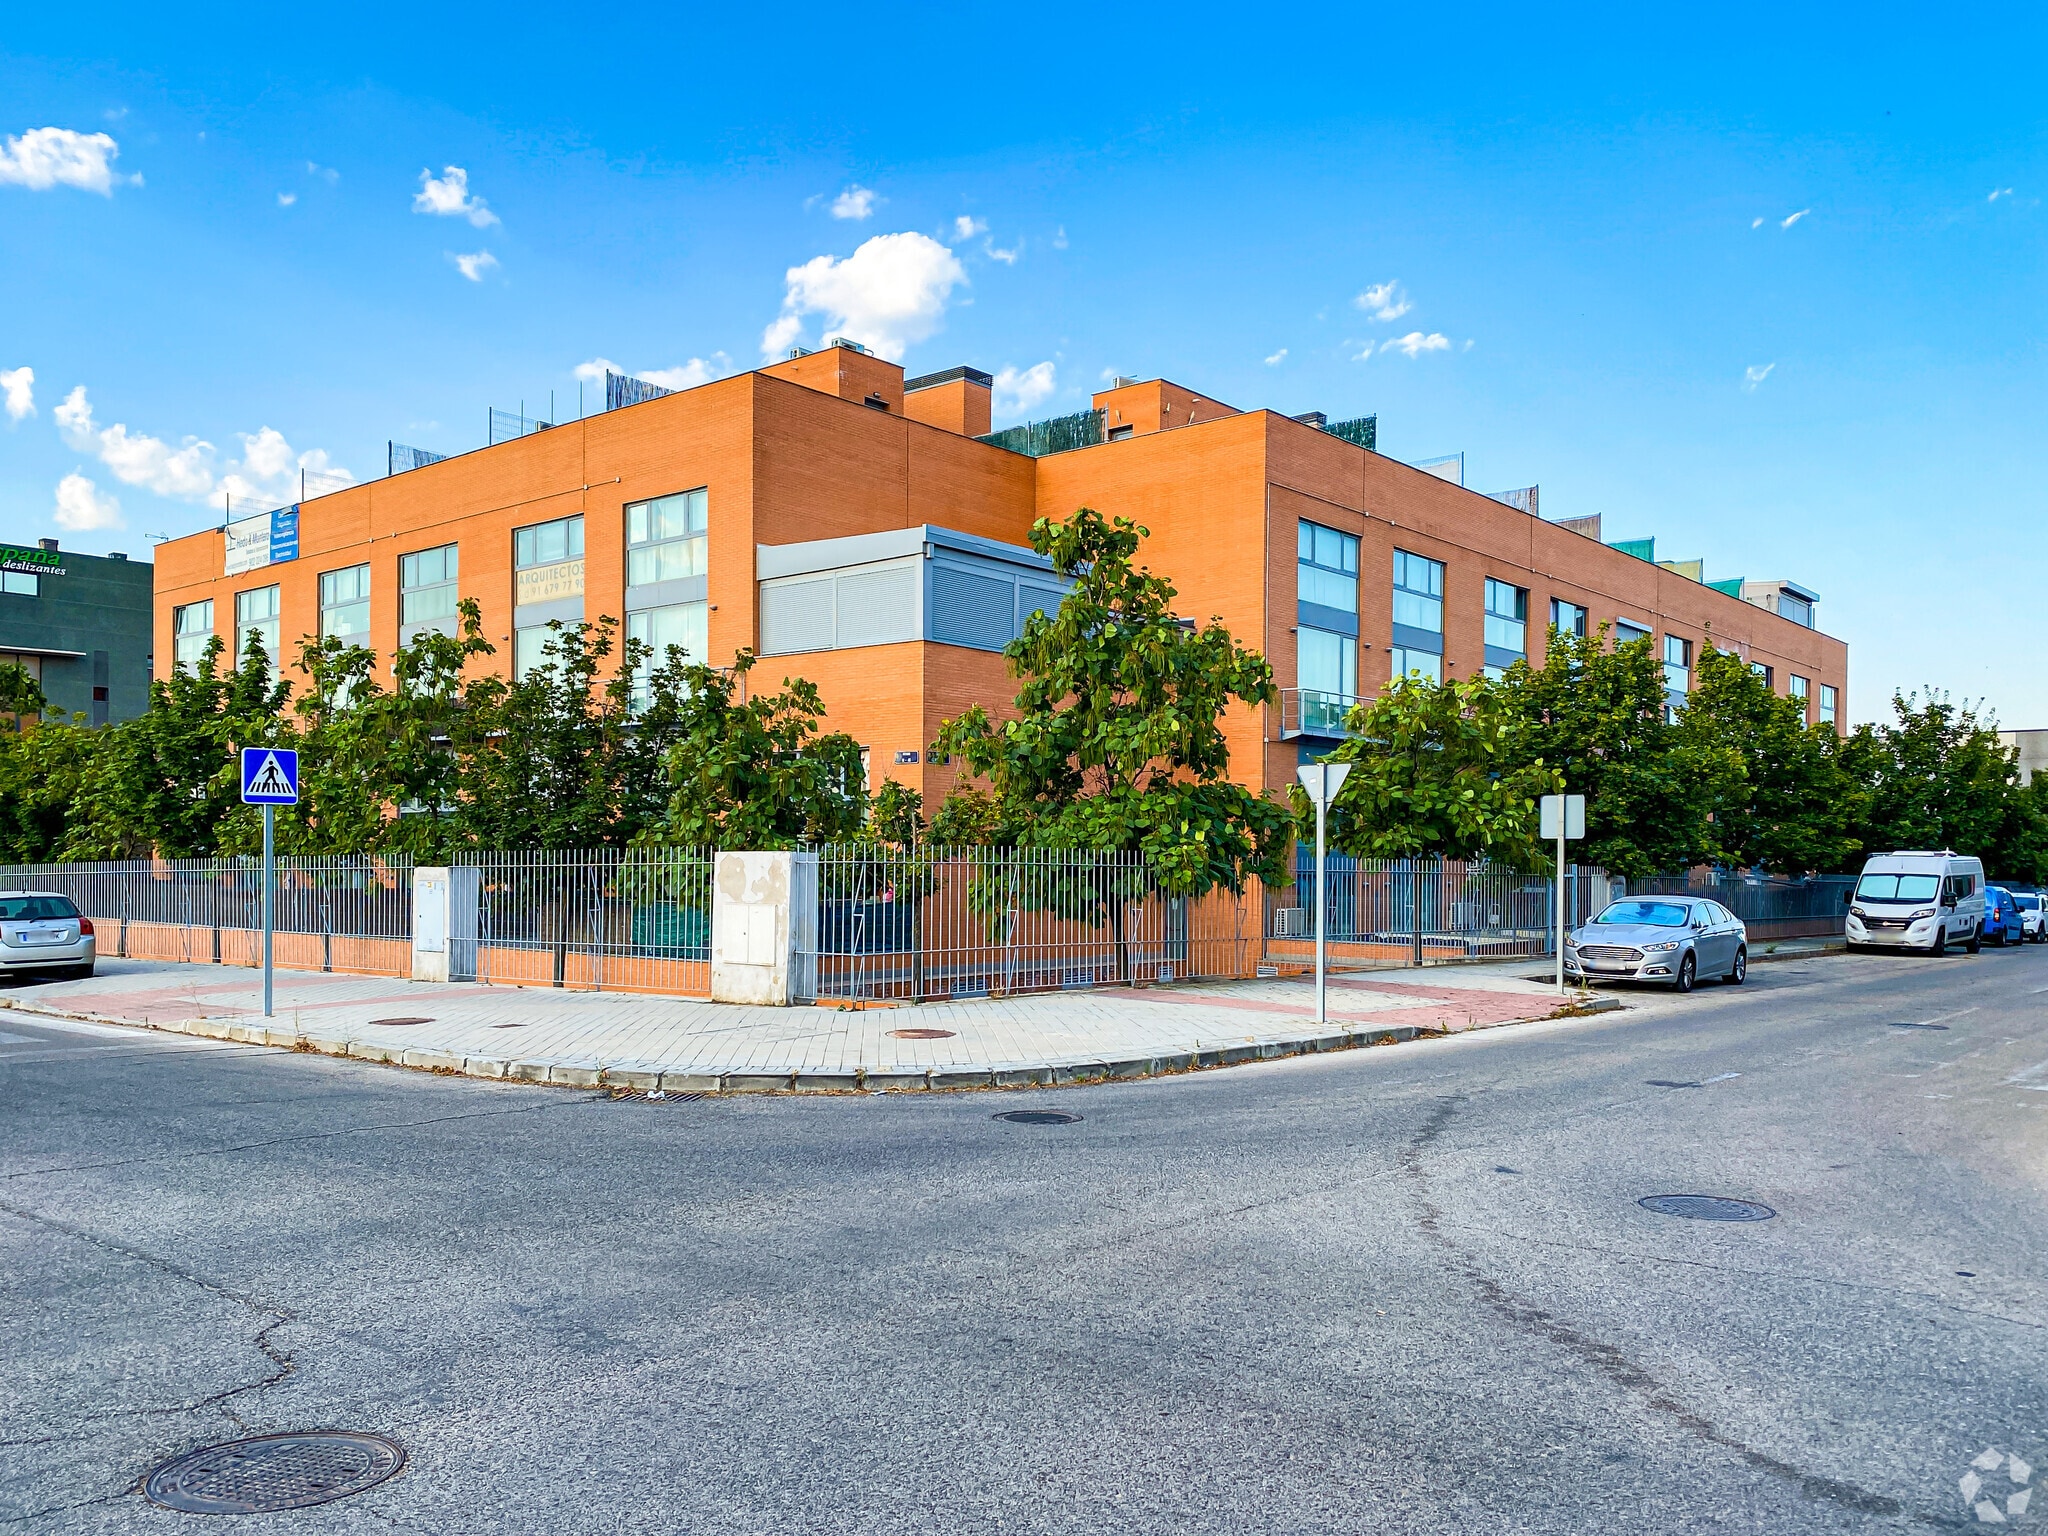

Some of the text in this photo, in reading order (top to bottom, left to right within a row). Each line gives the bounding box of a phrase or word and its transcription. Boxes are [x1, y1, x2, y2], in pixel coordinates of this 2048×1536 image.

[0, 546, 60, 566] paña
[2, 560, 67, 575] deslizantes
[518, 562, 584, 585] ARQUITECTOS
[544, 582, 559, 595] 679
